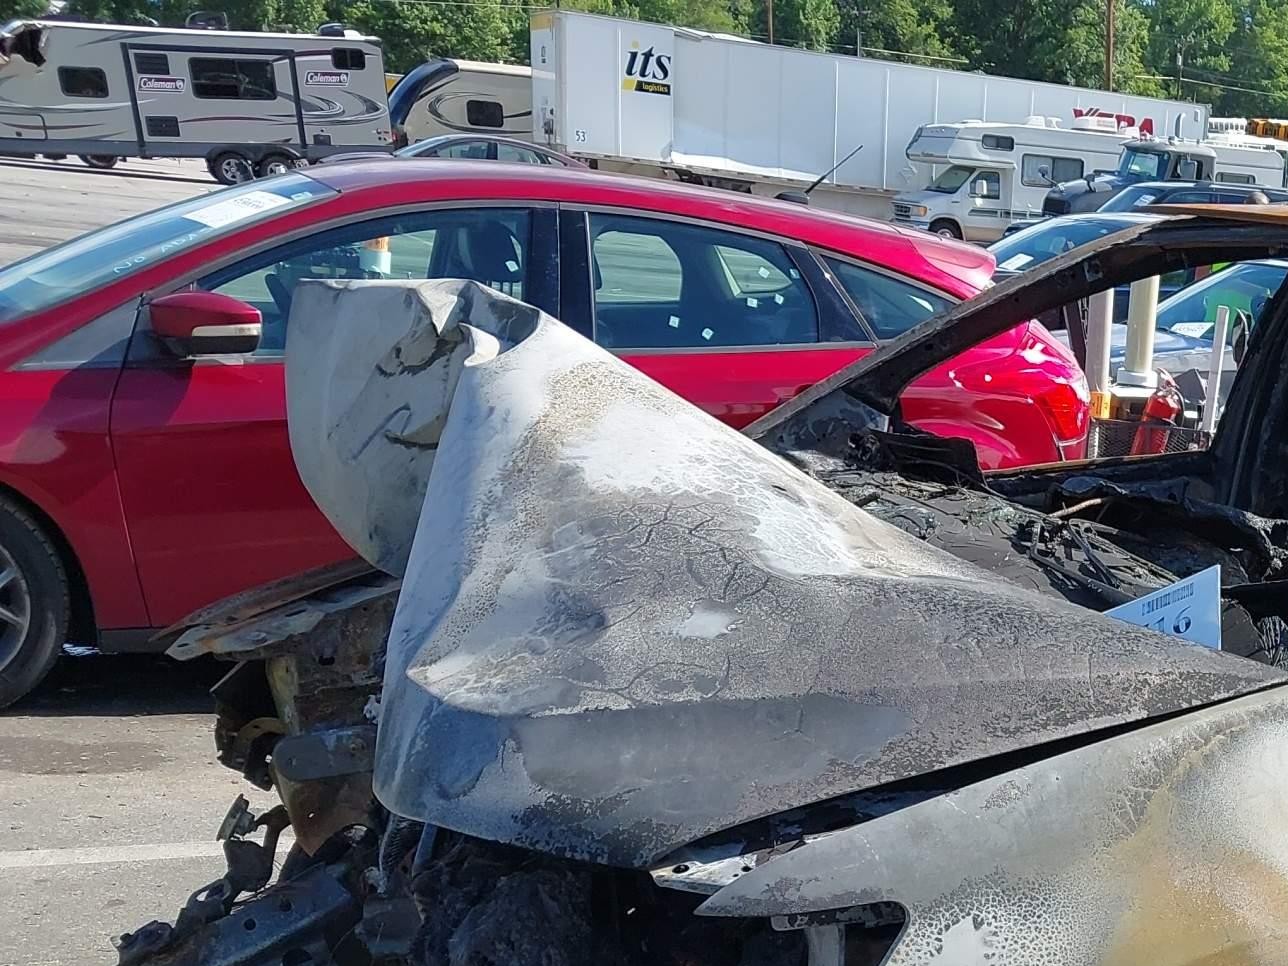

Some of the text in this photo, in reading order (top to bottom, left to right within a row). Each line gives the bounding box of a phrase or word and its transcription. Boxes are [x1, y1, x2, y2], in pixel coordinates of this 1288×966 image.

[624, 40, 672, 81] its
[140, 77, 176, 90] Coleman
[308, 71, 341, 84] Coleman
[642, 82, 669, 93] logistics
[575, 130, 586, 142] 53
